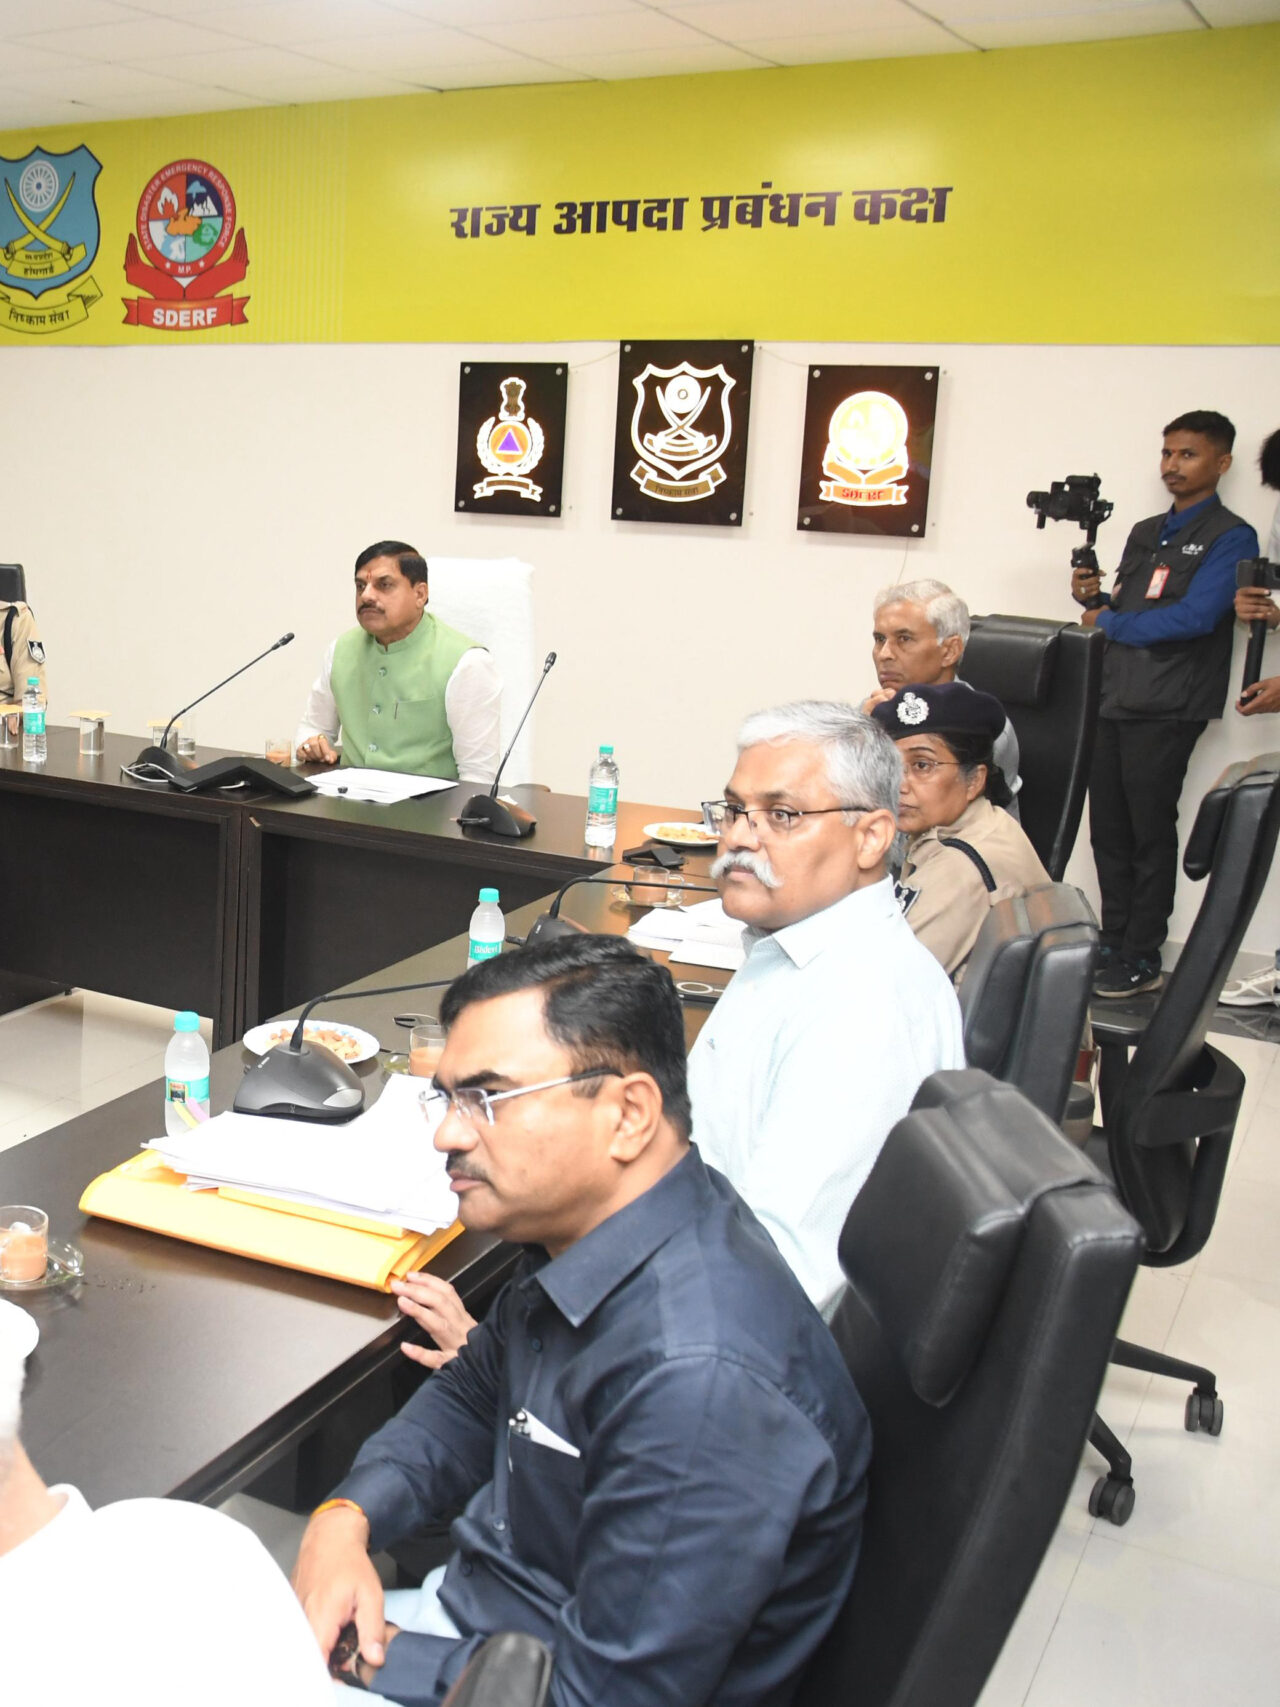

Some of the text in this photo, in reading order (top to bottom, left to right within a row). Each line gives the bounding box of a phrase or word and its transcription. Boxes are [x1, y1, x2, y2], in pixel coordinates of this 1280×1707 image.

[140, 163, 232, 250] STATE DISASTER EMERGENCY RESPONSE FORCE
[449, 181, 954, 239] राज्य आपदा प्रबंधन कक्ष
[8, 304, 70, 326] निष्काम सेवा
[152, 307, 218, 328] SDERF
